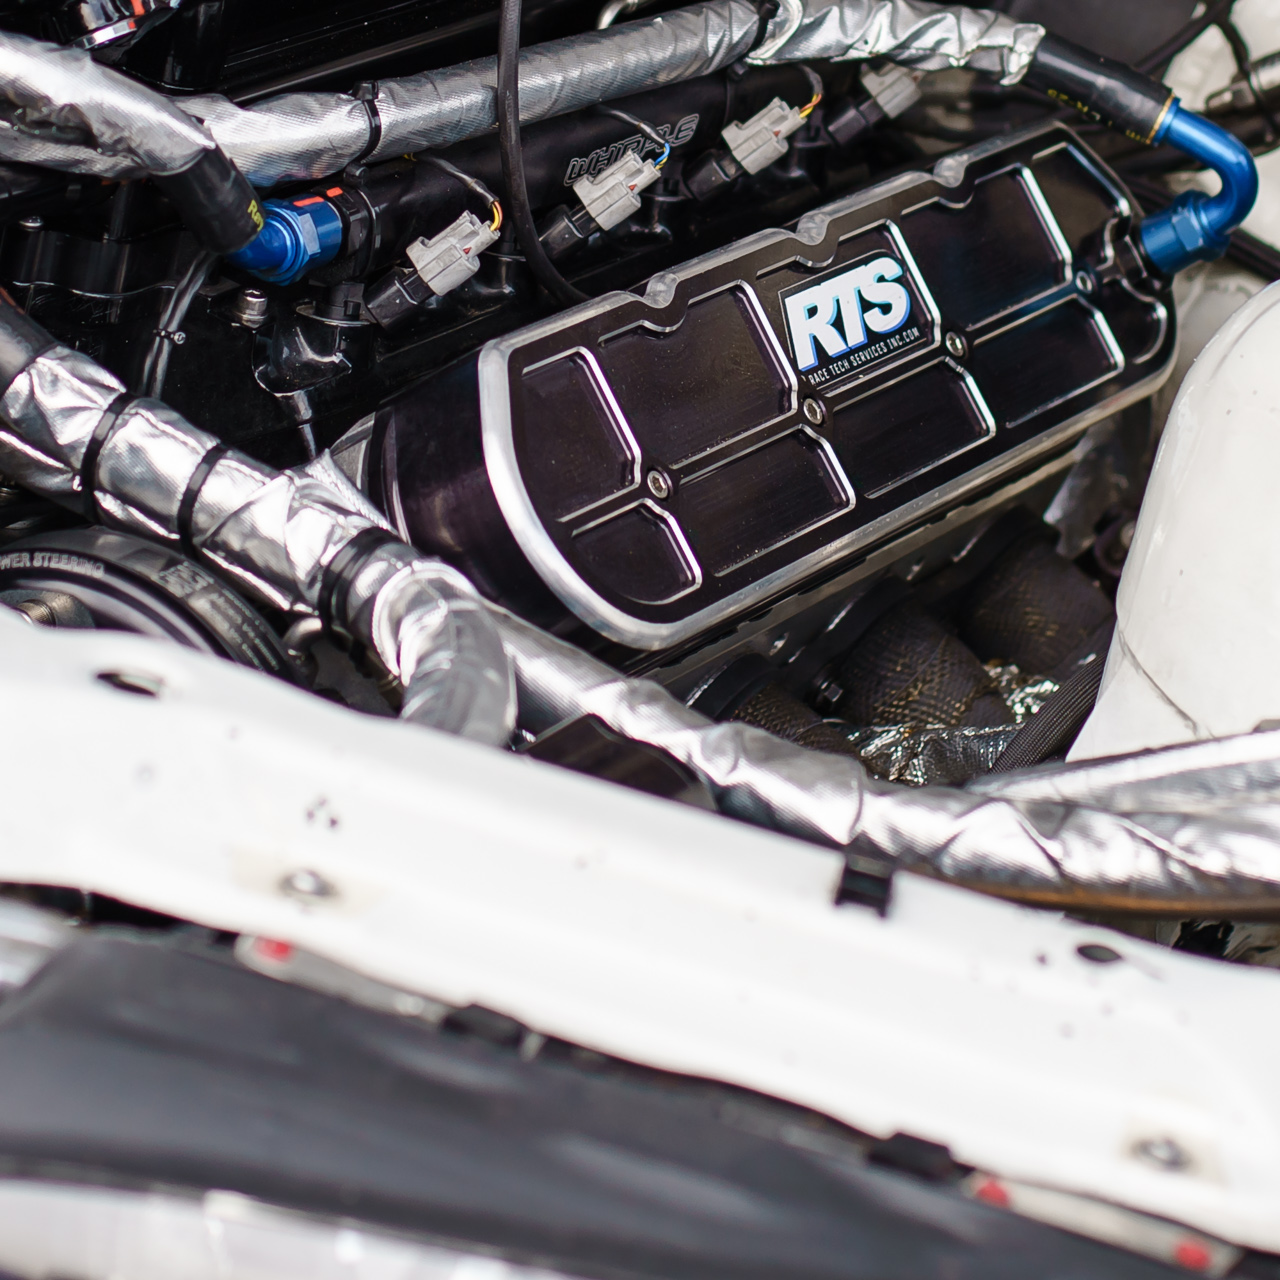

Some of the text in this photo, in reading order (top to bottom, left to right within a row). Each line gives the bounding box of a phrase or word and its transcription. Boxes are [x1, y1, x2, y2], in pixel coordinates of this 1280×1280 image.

[784, 256, 910, 372] RTS
[808, 370, 830, 386] RACE
[829, 359, 850, 376] TECH
[850, 343, 888, 368] SERVICES
[32, 551, 105, 578] STEERING
